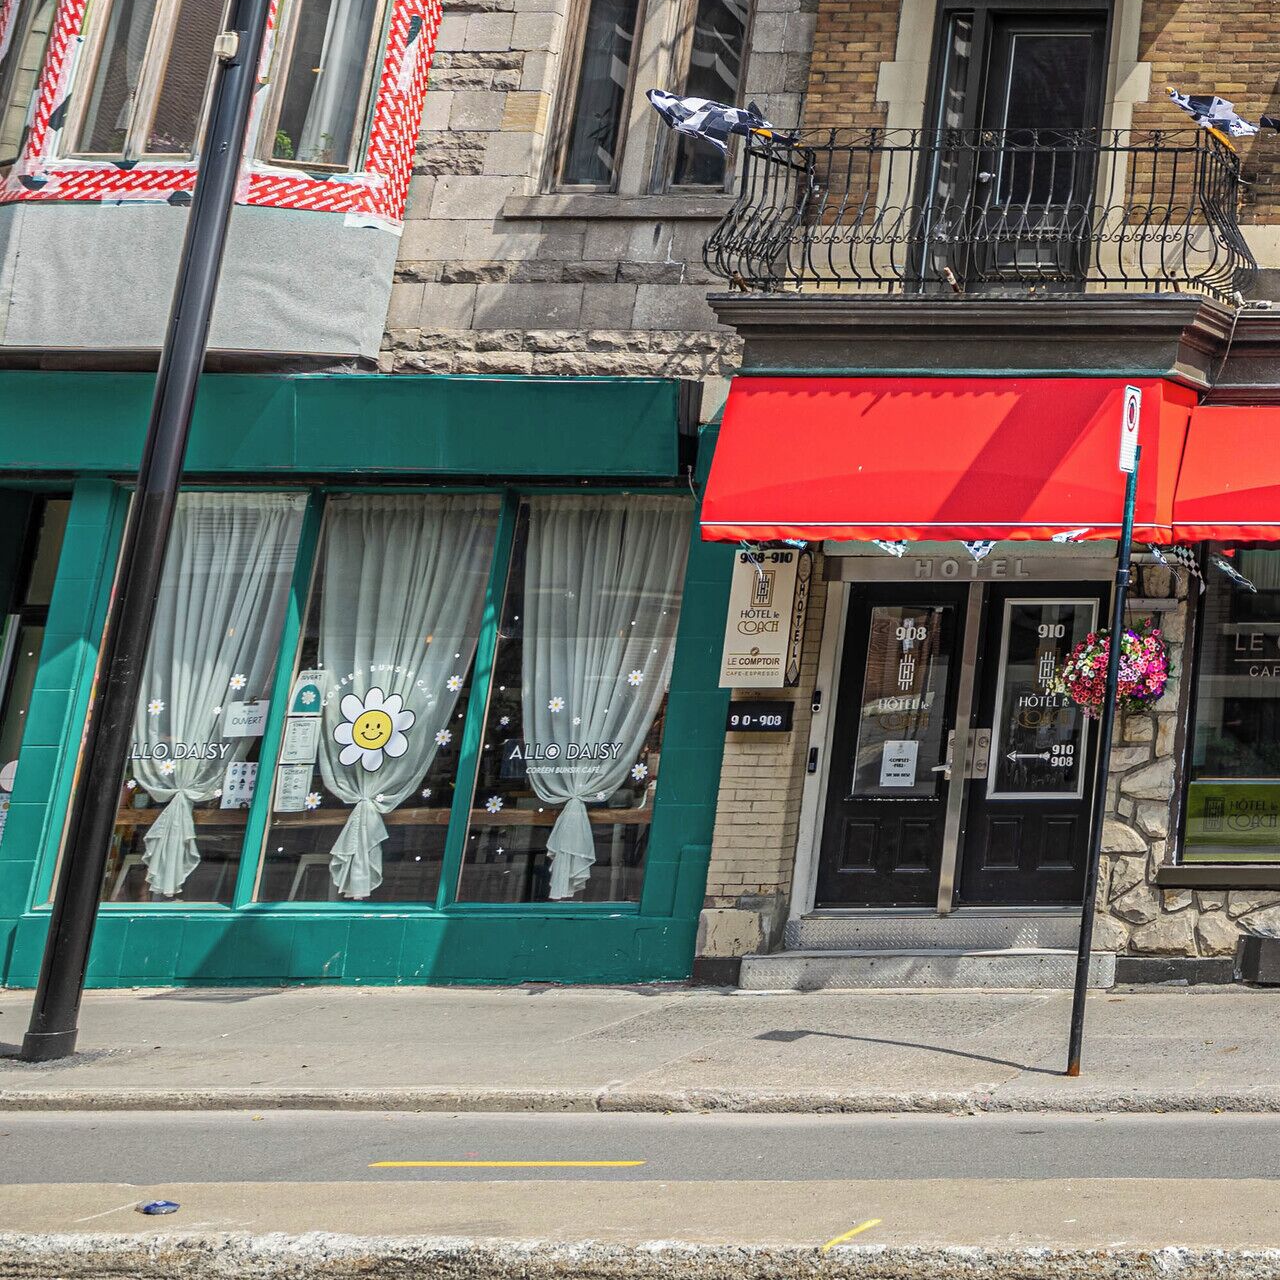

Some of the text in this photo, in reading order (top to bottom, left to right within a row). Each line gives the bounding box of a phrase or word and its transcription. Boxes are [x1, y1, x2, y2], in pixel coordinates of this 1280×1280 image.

[740, 552, 793, 564] 908-910
[915, 558, 1030, 578] HOTEL
[740, 607, 771, 619] HÔTEL
[792, 583, 805, 658] HOTEL
[737, 621, 779, 635] COACH
[896, 627, 927, 640] 908
[1038, 624, 1065, 638] 910
[1235, 632, 1264, 651] LE
[727, 658, 780, 666] LE COMPTOIR
[878, 696, 918, 710] HÔTEL
[1019, 693, 1058, 707] HÔTEL
[232, 715, 263, 726] OUVERT
[731, 715, 782, 726] 90-908
[127, 743, 231, 760] LLO DAISY
[509, 743, 623, 760] ALLO DAISY
[1052, 744, 1074, 755] 910
[1051, 756, 1074, 767] 908
[525, 765, 600, 774] CORÉEN BUNSIK CAFÉ
[1230, 797, 1267, 811] HÔTEL
[1227, 814, 1278, 831] COACH
